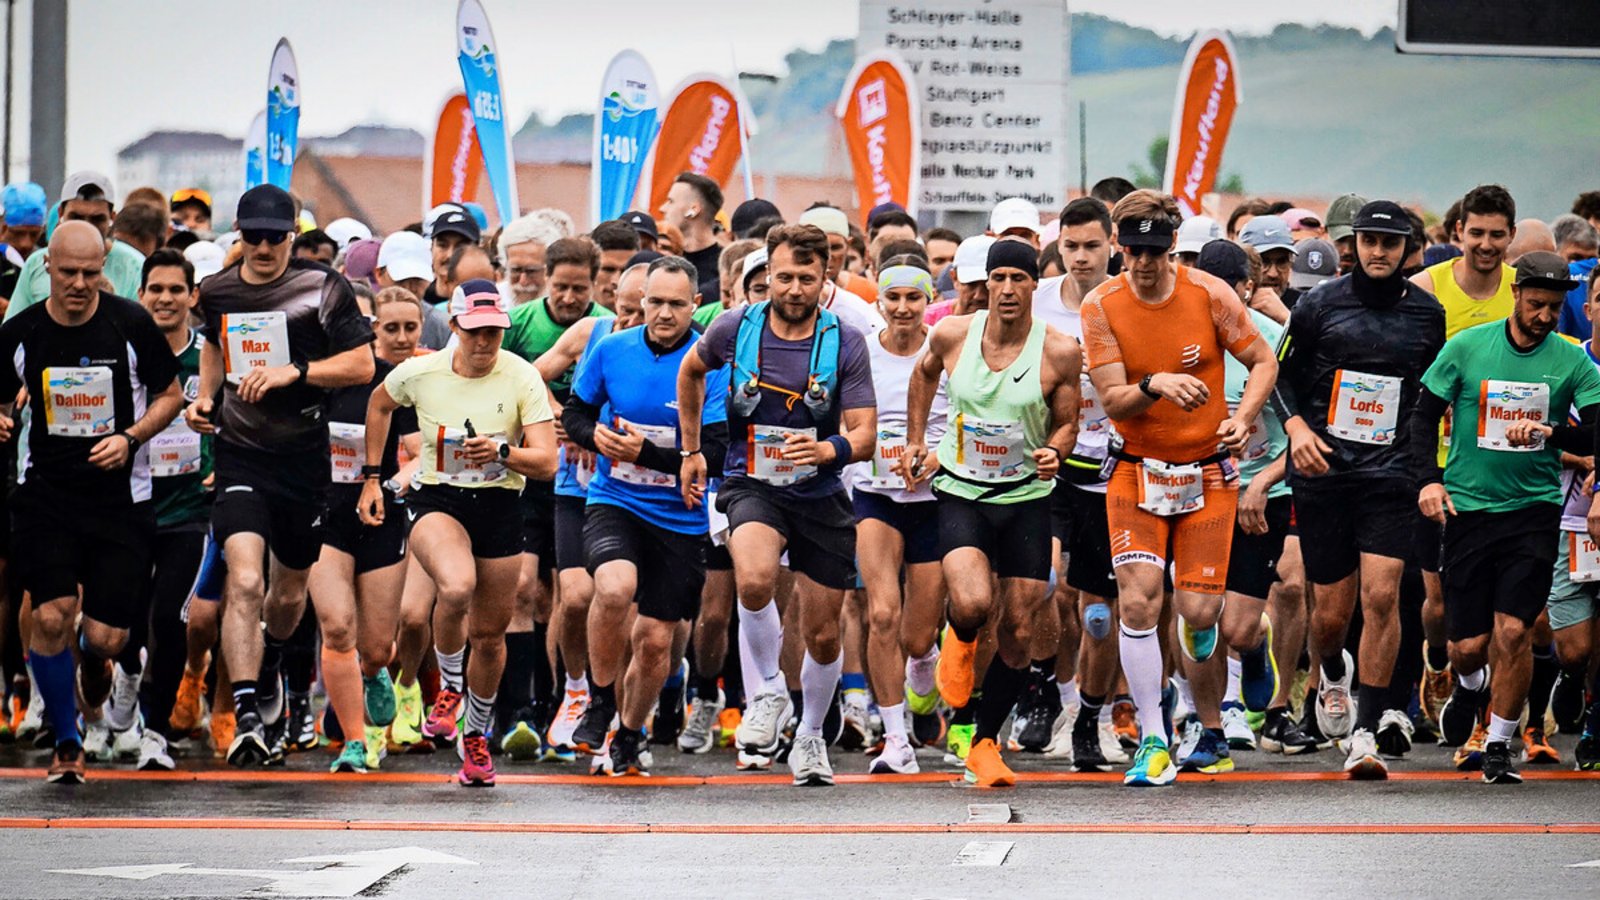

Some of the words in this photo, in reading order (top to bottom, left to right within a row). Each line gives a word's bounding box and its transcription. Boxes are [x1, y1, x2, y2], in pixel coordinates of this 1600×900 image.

[887, 8, 1023, 28] Schleyer-Halle
[885, 33, 1023, 51] Porsche-Arena
[930, 112, 975, 128] Benz
[983, 112, 1041, 128] Center
[1184, 57, 1228, 201] Kaufland
[242, 339, 271, 354] Max
[55, 393, 107, 408] Dalibor
[1349, 396, 1385, 414] Loris
[1490, 406, 1543, 421] Markus
[974, 439, 1009, 456] Timo
[1147, 471, 1197, 488] Markus
